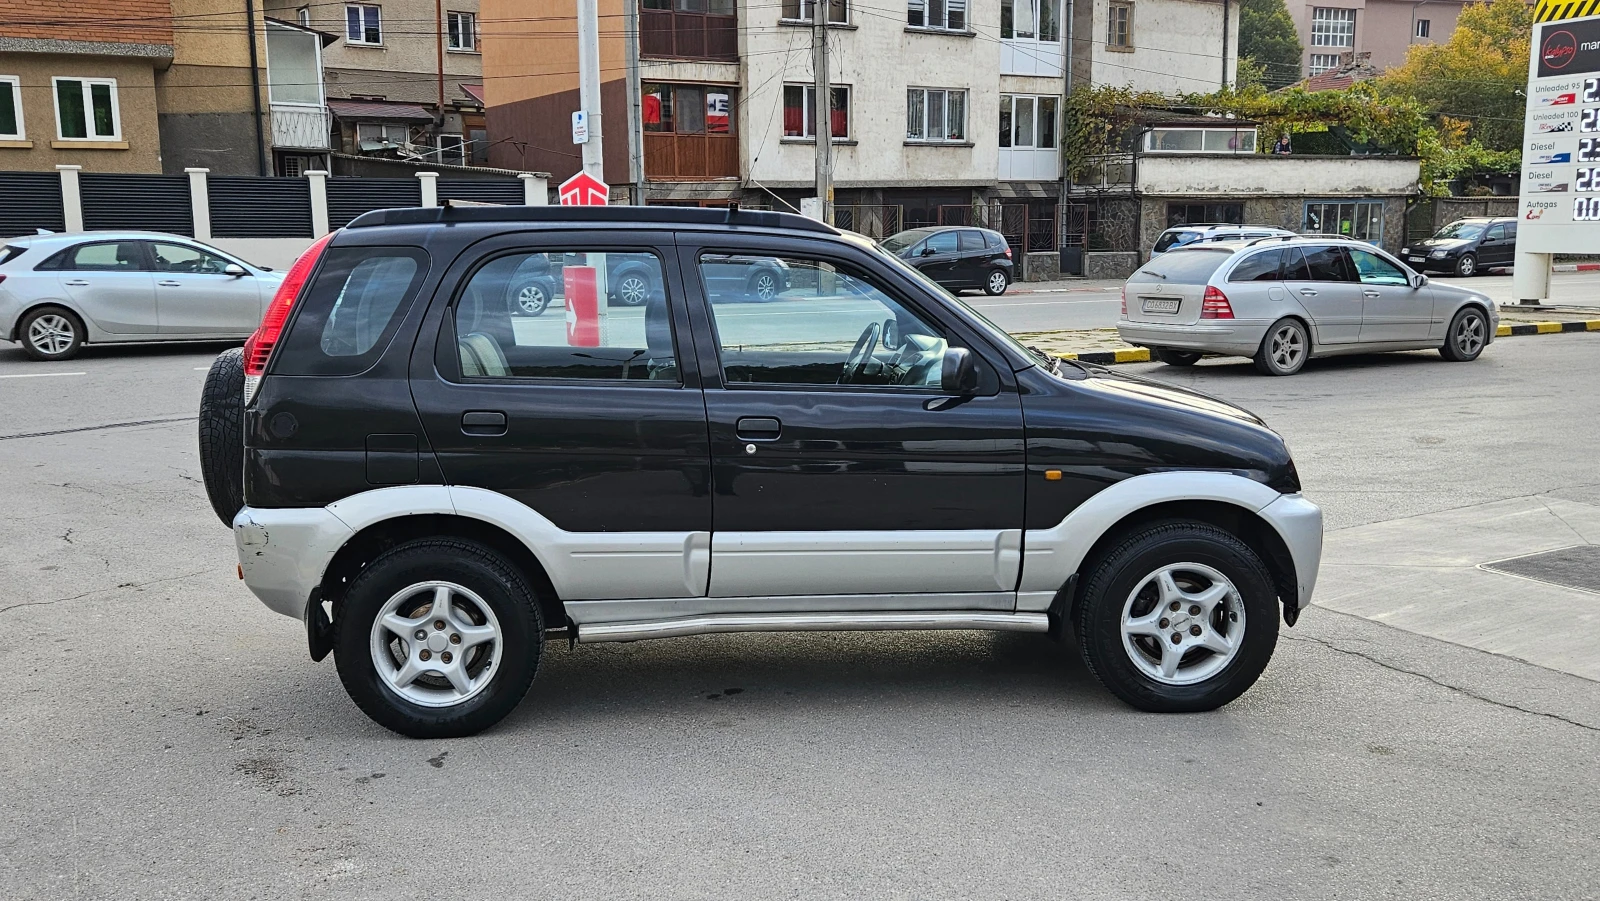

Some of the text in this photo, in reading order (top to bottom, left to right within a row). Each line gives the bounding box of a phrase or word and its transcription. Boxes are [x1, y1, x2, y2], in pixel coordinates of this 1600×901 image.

[1535, 85, 1569, 93] Unleaded
[1533, 112, 1565, 121] Unleaded
[1581, 109, 1600, 132] 2.
[1530, 142, 1555, 151] Diesel
[1528, 171, 1553, 180] Diesel
[1526, 201, 1558, 210] Autogas
